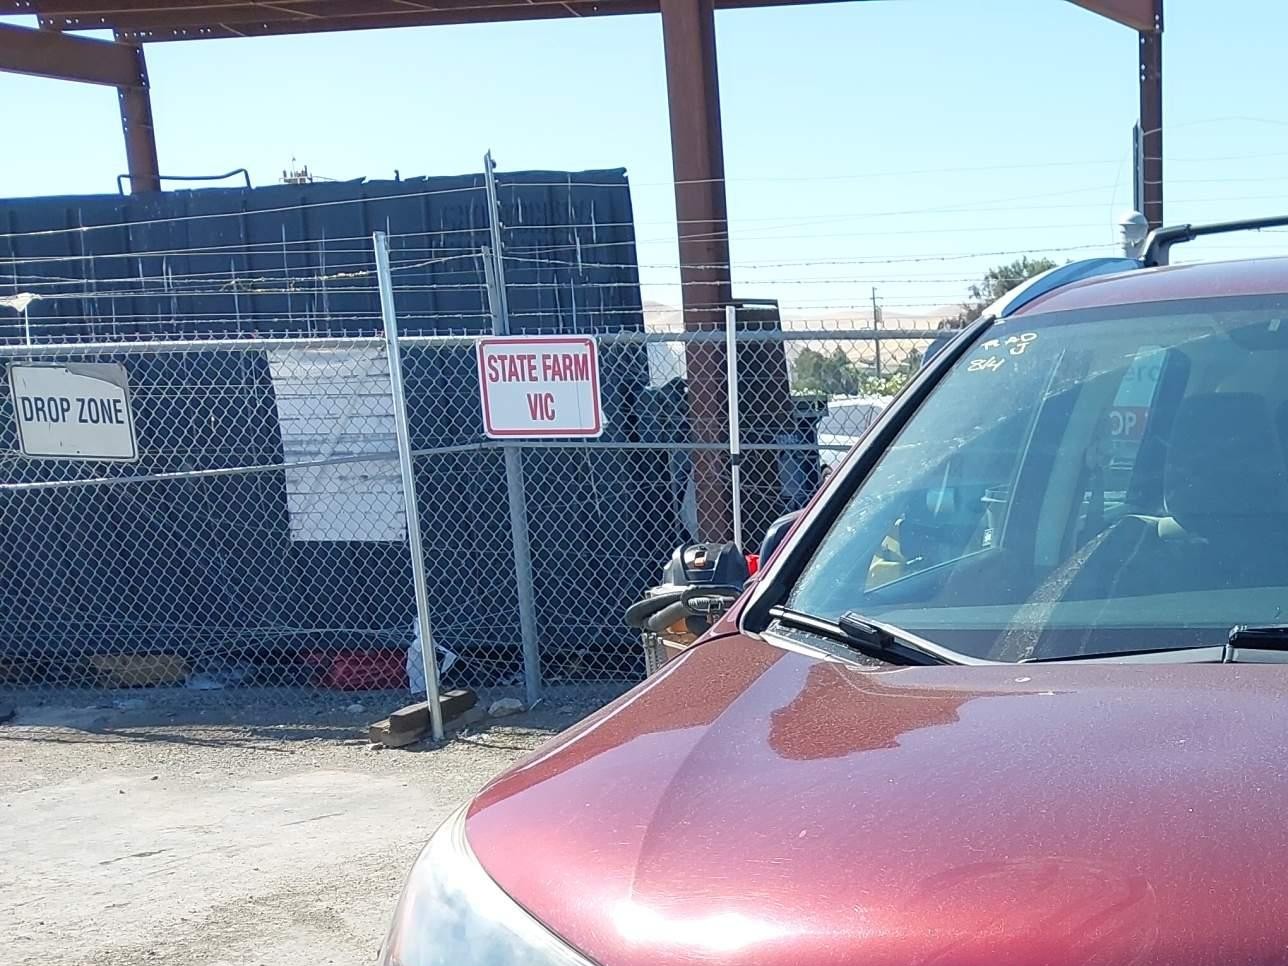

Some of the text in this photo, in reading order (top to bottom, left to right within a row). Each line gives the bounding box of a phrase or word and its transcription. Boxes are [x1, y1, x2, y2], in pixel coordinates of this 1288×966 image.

[487, 353, 590, 382] STATE FARM
[20, 396, 125, 424] DROP ZONE
[526, 393, 556, 421] VIC
